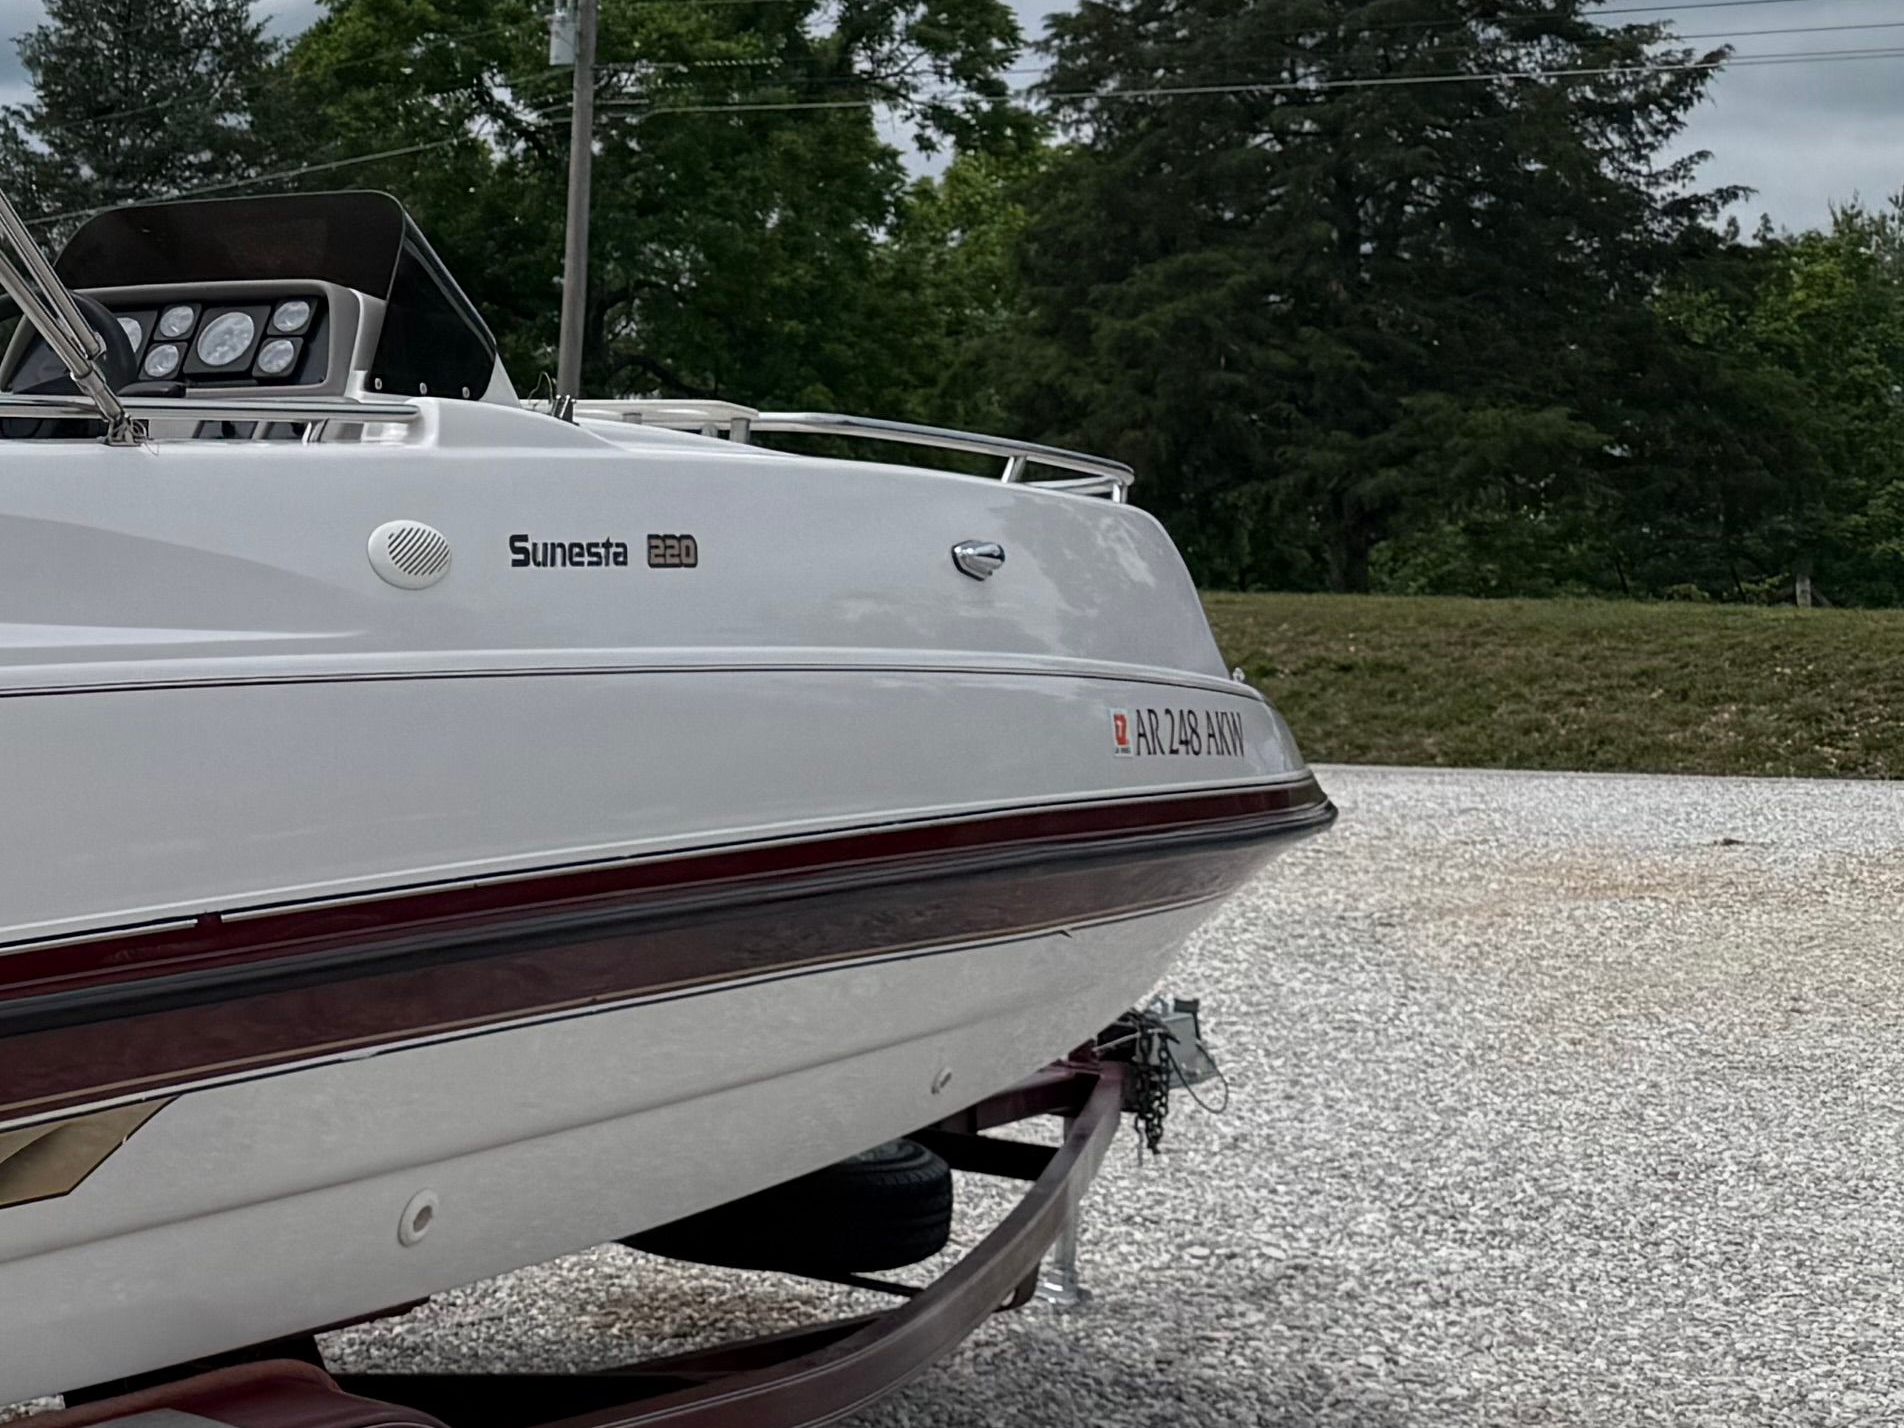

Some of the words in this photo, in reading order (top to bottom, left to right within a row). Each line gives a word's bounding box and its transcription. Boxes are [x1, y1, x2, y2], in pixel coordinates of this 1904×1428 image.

[509, 534, 628, 568] Sunesta
[647, 533, 698, 569] 220
[1135, 708, 1166, 756] AR
[1164, 708, 1203, 756] 248
[1205, 710, 1245, 757] AKW
